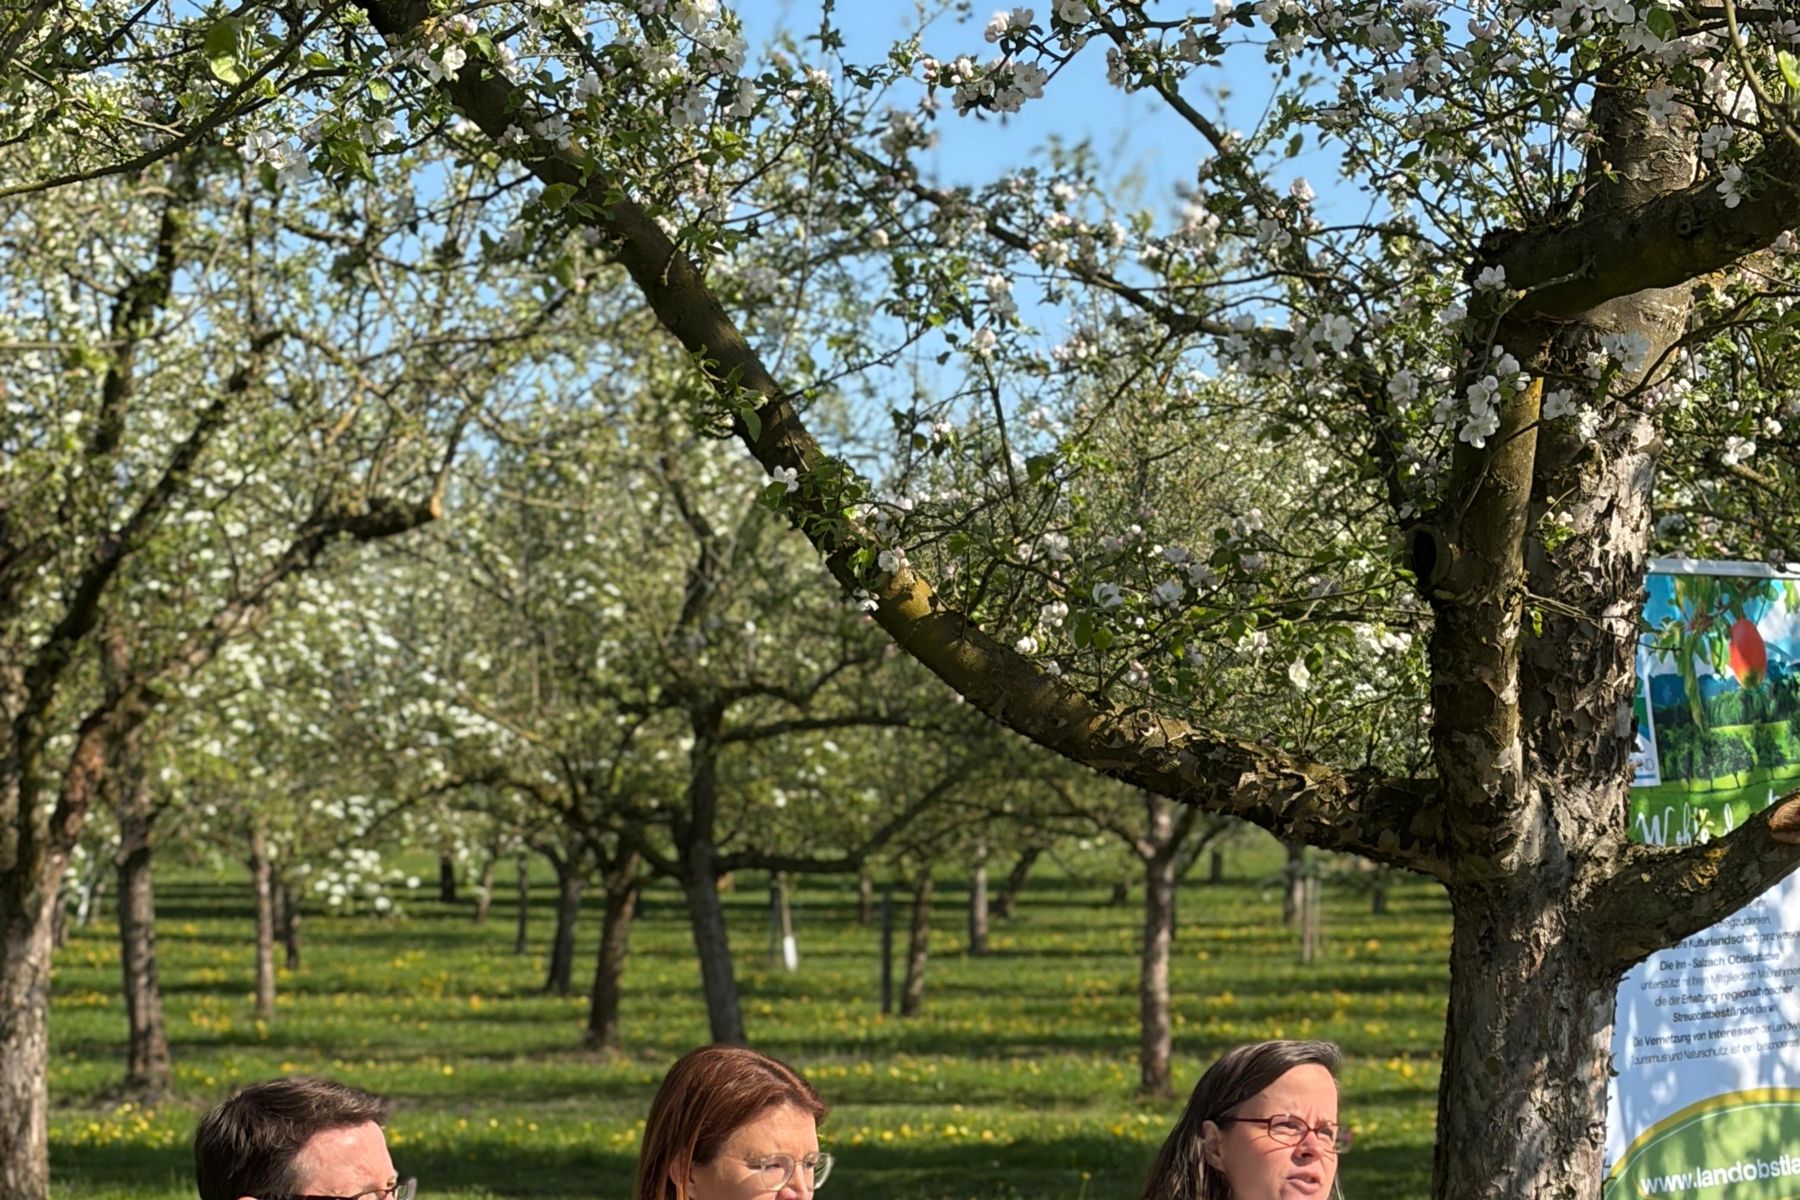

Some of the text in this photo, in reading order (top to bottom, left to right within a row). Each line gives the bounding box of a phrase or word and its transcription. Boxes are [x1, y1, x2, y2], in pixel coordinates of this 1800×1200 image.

[1660, 960, 1674, 971] Die
[1693, 956, 1725, 968] Salzach
[1644, 1033, 1691, 1047] Vernetzung
[1693, 1030, 1707, 1041] von
[1708, 1025, 1759, 1039] Interessen
[1684, 1046, 1728, 1060] Naturschutz
